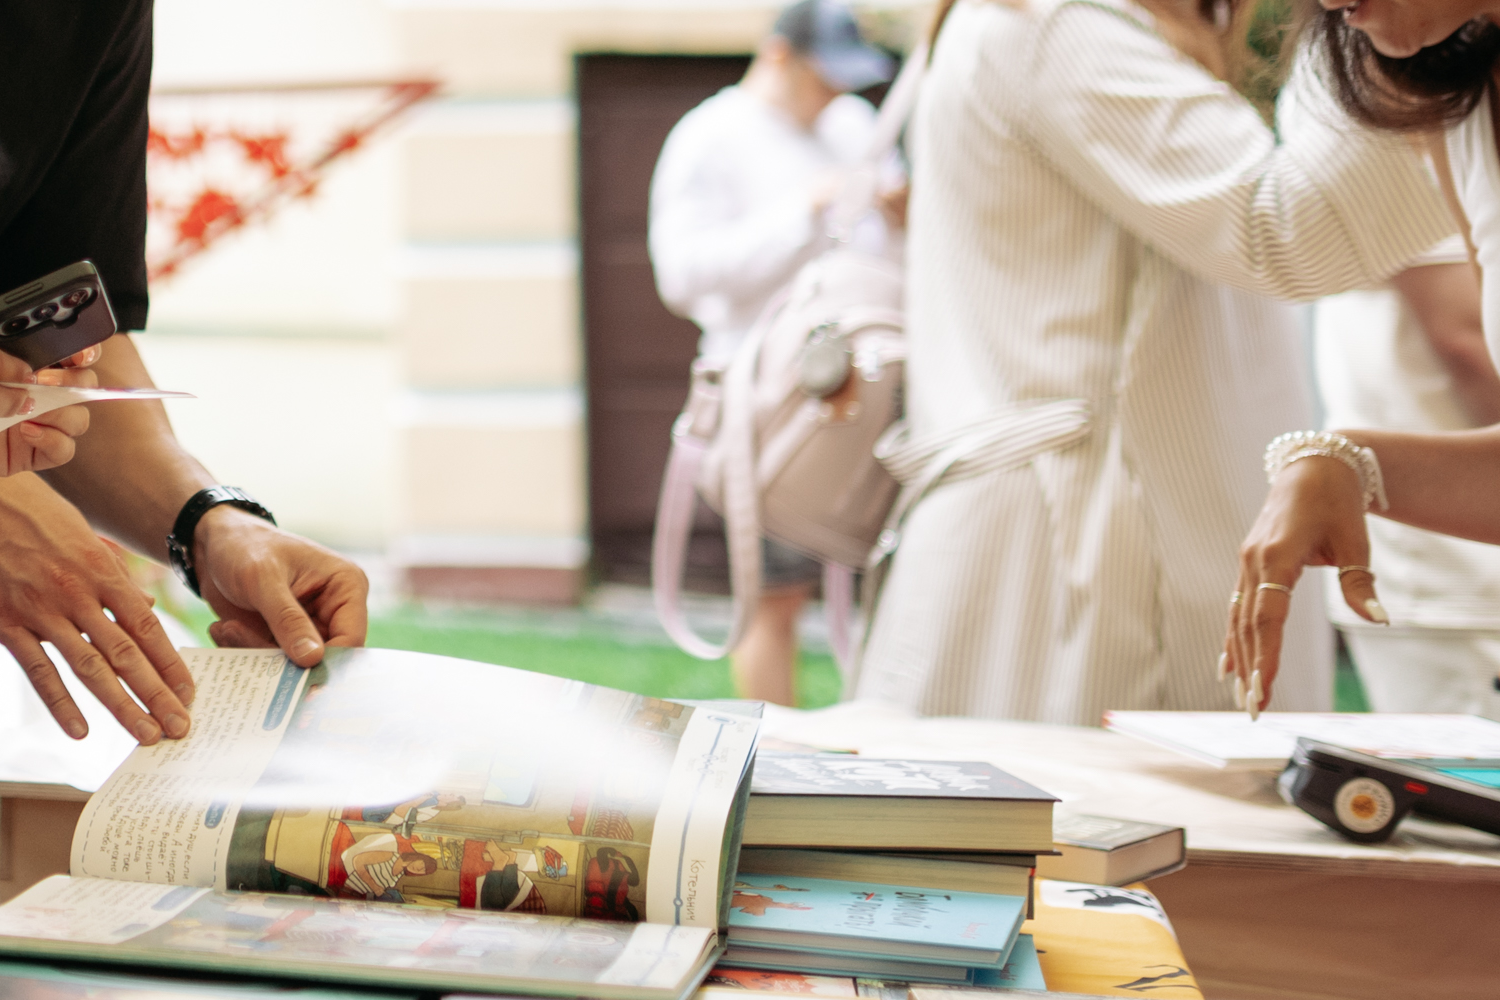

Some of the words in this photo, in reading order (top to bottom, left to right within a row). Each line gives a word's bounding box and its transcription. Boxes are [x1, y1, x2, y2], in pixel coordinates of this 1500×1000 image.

[99, 824, 115, 854] любой
[125, 818, 137, 846] услуга
[151, 826, 158, 835] ты
[111, 843, 120, 872] можно
[157, 832, 170, 866] выдаёт
[166, 850, 177, 885] иногда
[183, 855, 193, 880] если
[685, 859, 706, 921] Котельнич
